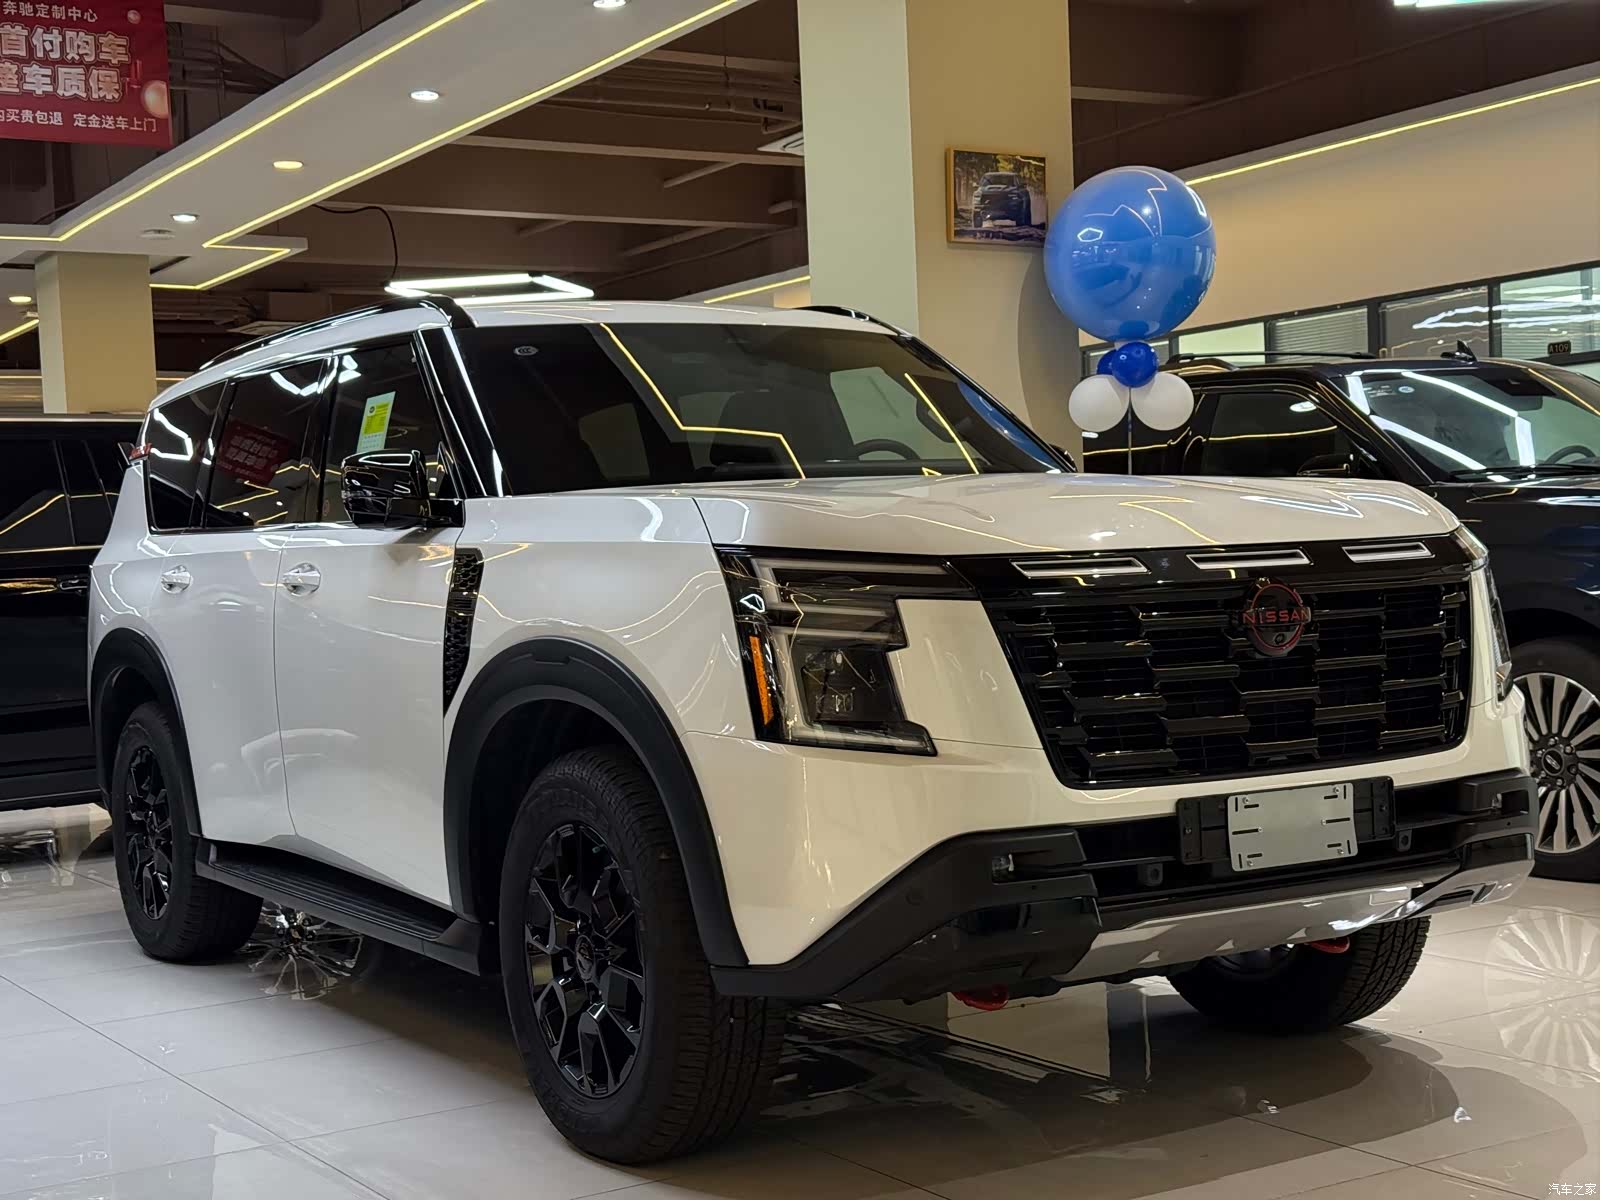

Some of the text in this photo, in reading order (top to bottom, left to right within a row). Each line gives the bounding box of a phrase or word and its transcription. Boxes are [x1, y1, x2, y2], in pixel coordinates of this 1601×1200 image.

[2, 1, 98, 23] 奔驰定制中心
[0, 24, 129, 65] 首付购车
[73, 113, 157, 132] 定金送车上门
[1549, 343, 1569, 353] A109
[1242, 608, 1310, 624] NISSAN
